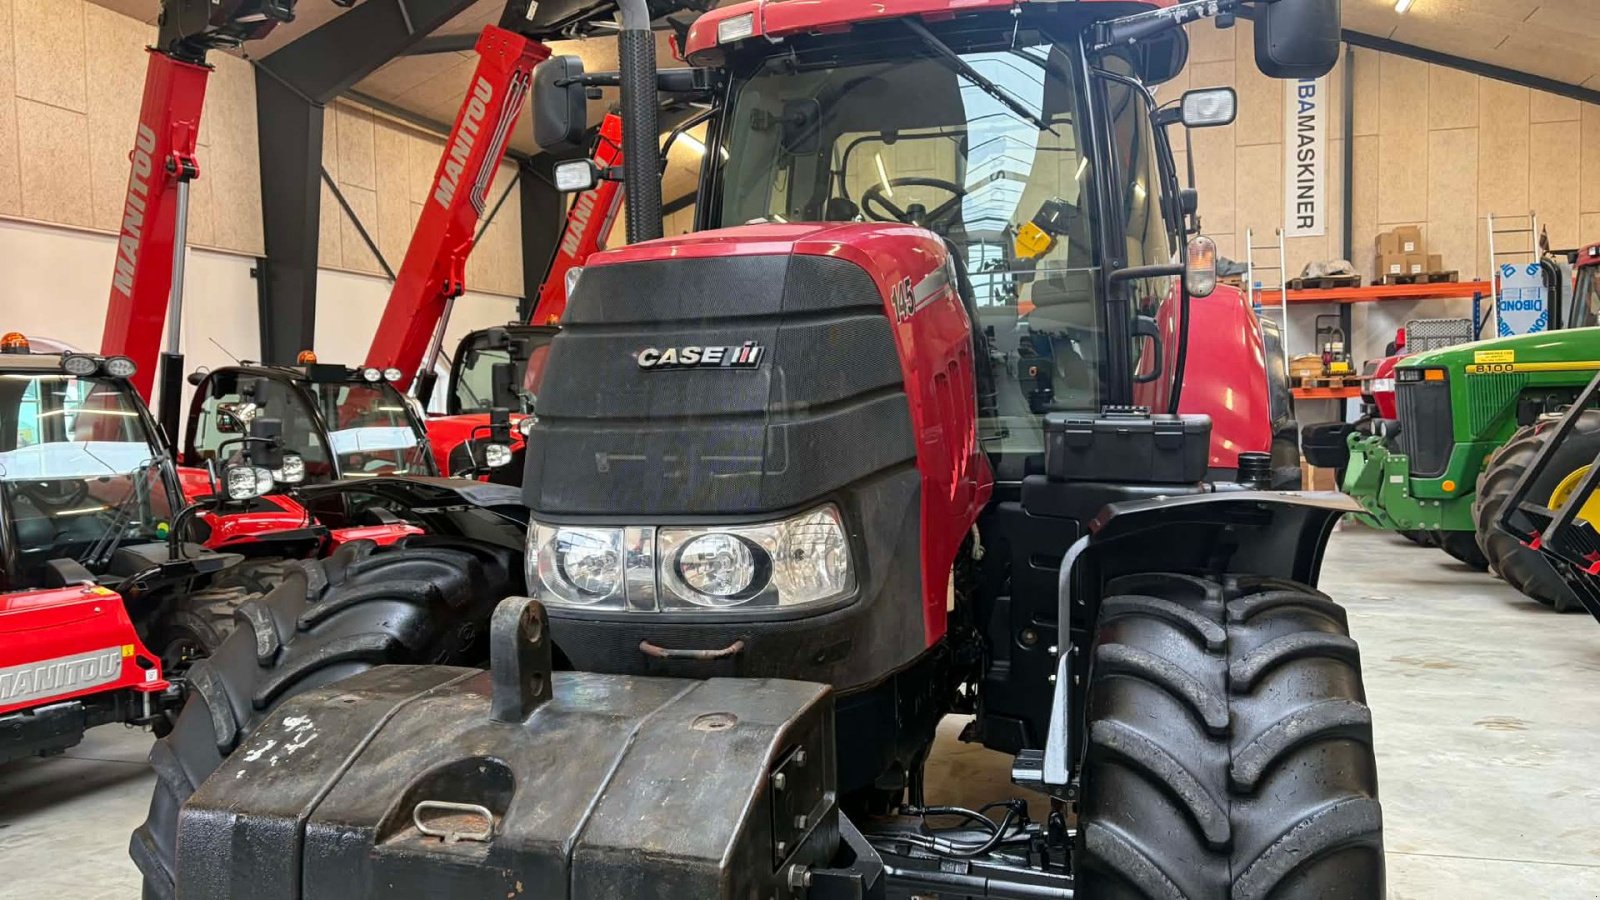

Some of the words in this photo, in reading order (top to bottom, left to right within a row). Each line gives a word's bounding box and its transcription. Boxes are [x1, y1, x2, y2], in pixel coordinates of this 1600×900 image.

[434, 75, 493, 210] MANITOU
[1297, 78, 1315, 229] BAMASKINER
[114, 122, 156, 298] MANITOU
[891, 275, 915, 325] 145
[1500, 300, 1542, 311] DIBOND
[637, 346, 724, 369] CASE
[1476, 364, 1514, 373] 8100
